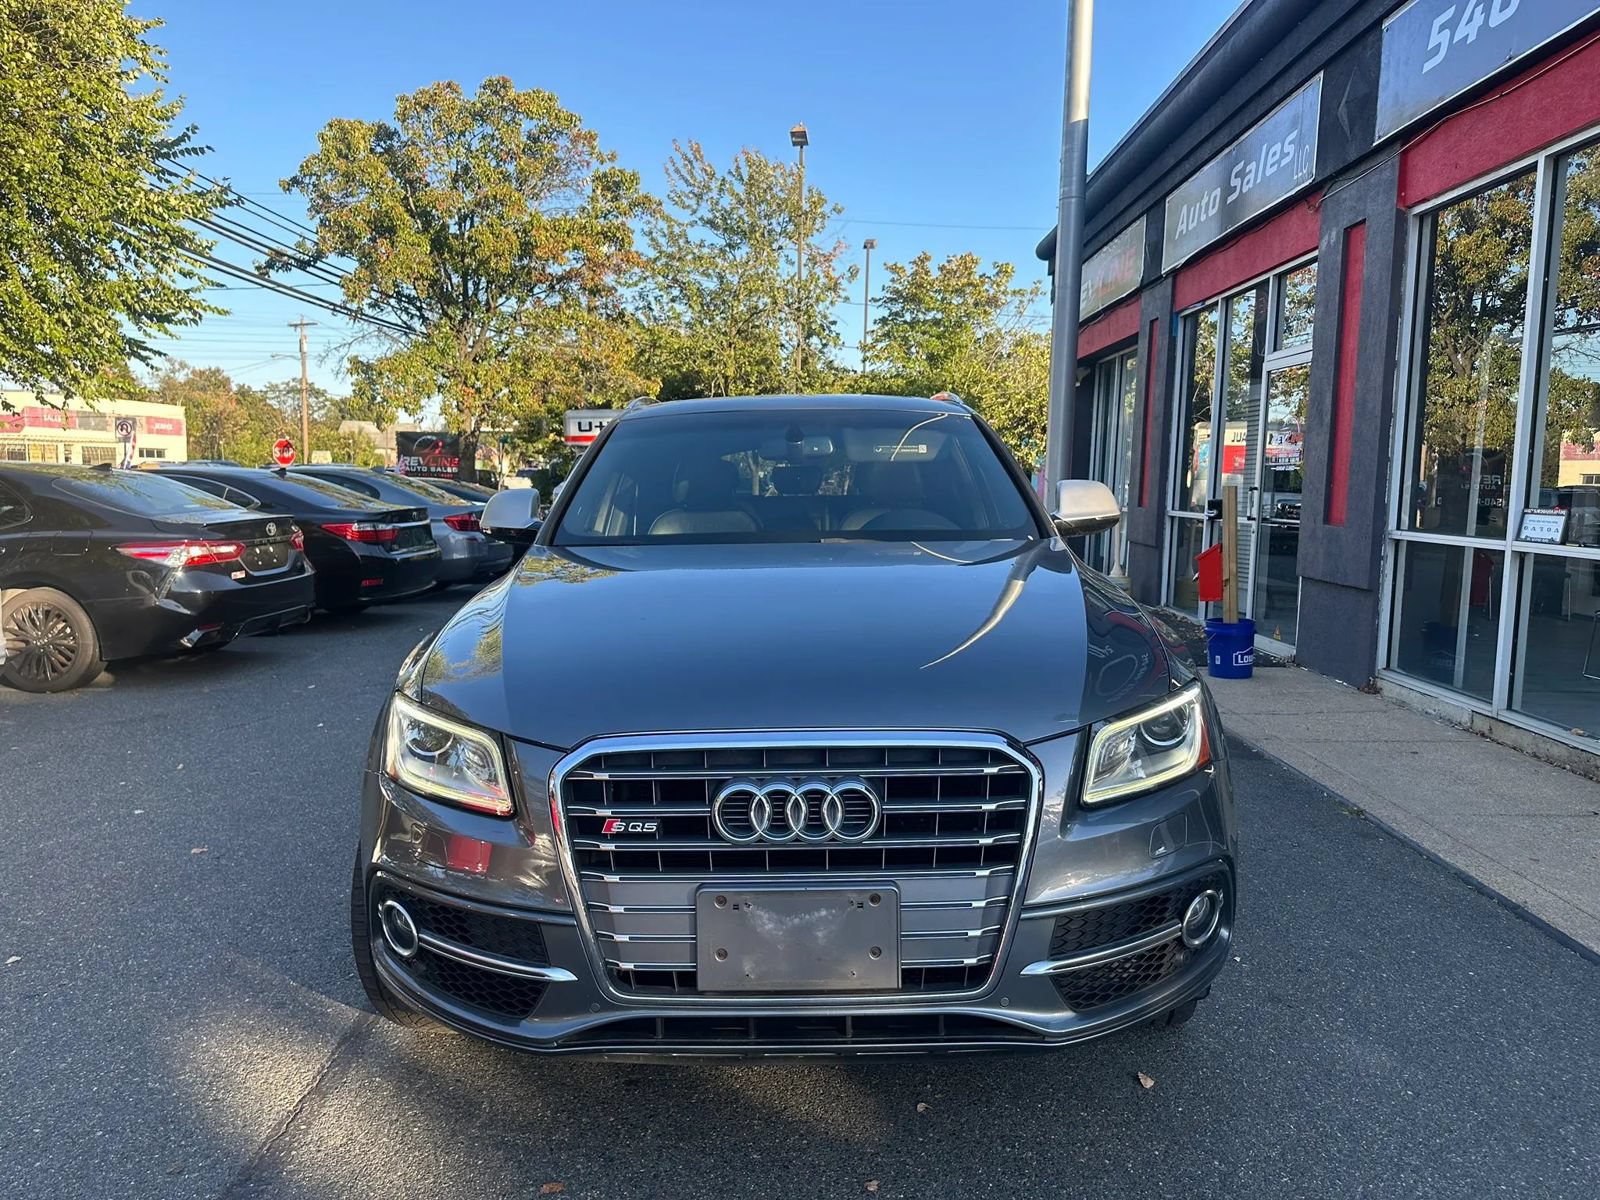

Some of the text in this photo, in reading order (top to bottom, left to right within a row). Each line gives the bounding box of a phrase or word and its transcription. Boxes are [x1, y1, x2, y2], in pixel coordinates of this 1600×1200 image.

[1175, 129, 1310, 240] Auto Sales LLC
[275, 447, 294, 458] STOP
[611, 822, 658, 832] SQ5
